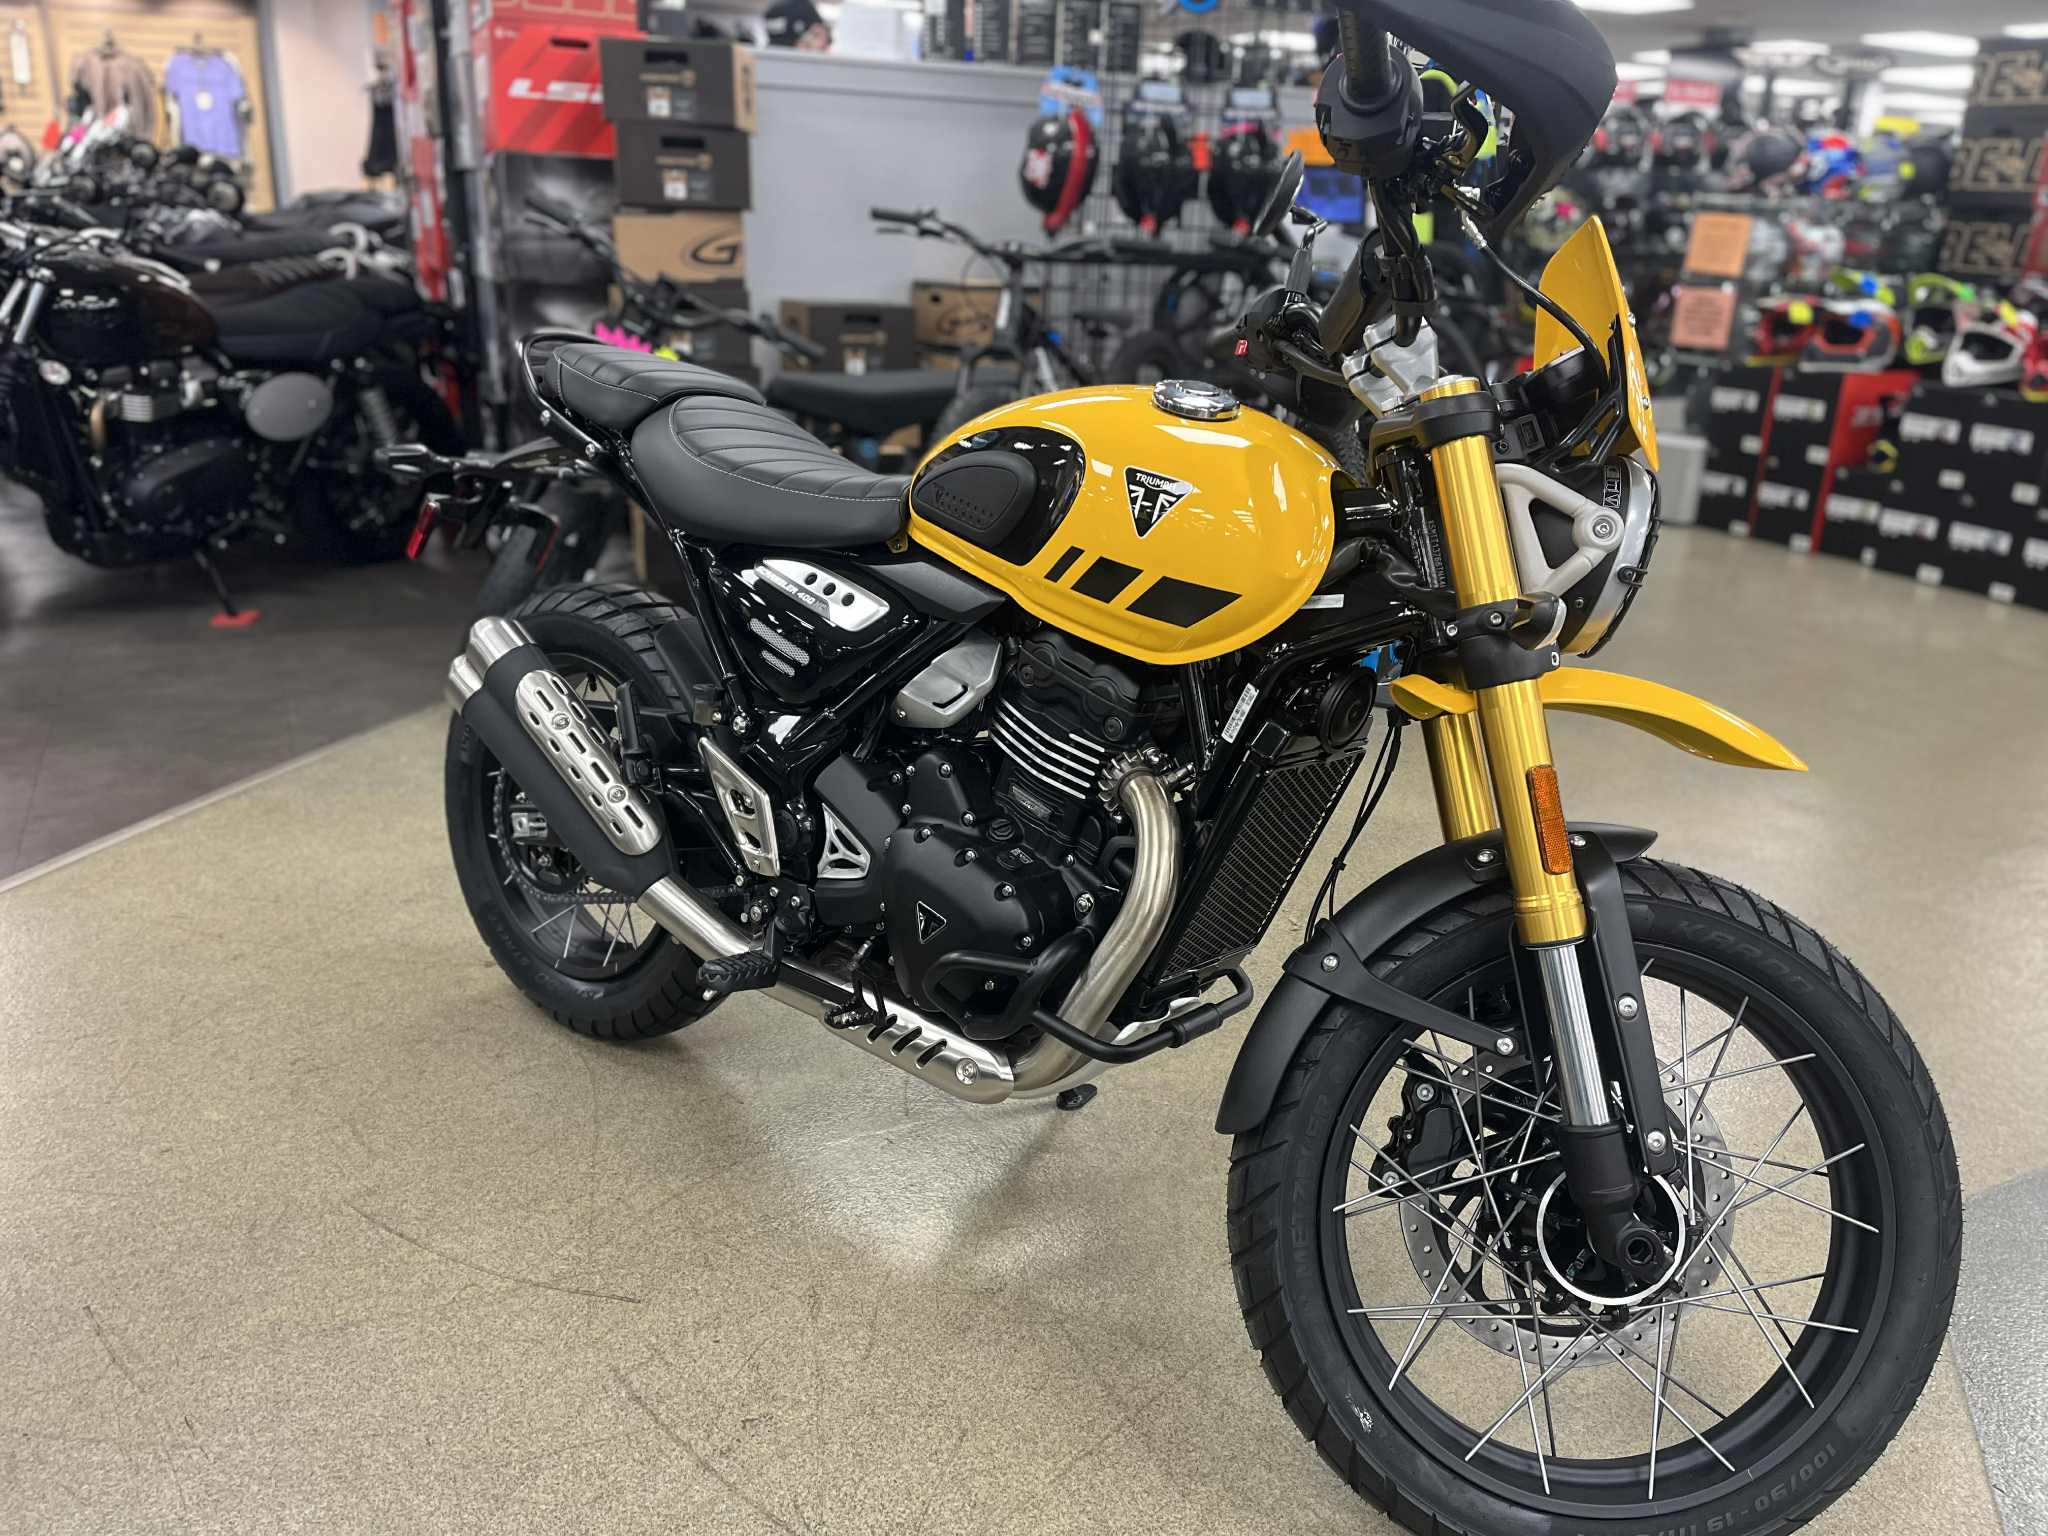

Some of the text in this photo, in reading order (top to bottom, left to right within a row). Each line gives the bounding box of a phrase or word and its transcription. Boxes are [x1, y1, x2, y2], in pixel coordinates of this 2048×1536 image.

[1135, 471, 1178, 491] TRIUMPH
[796, 591, 816, 605] 400
[1754, 1443, 1838, 1513] 100/90
